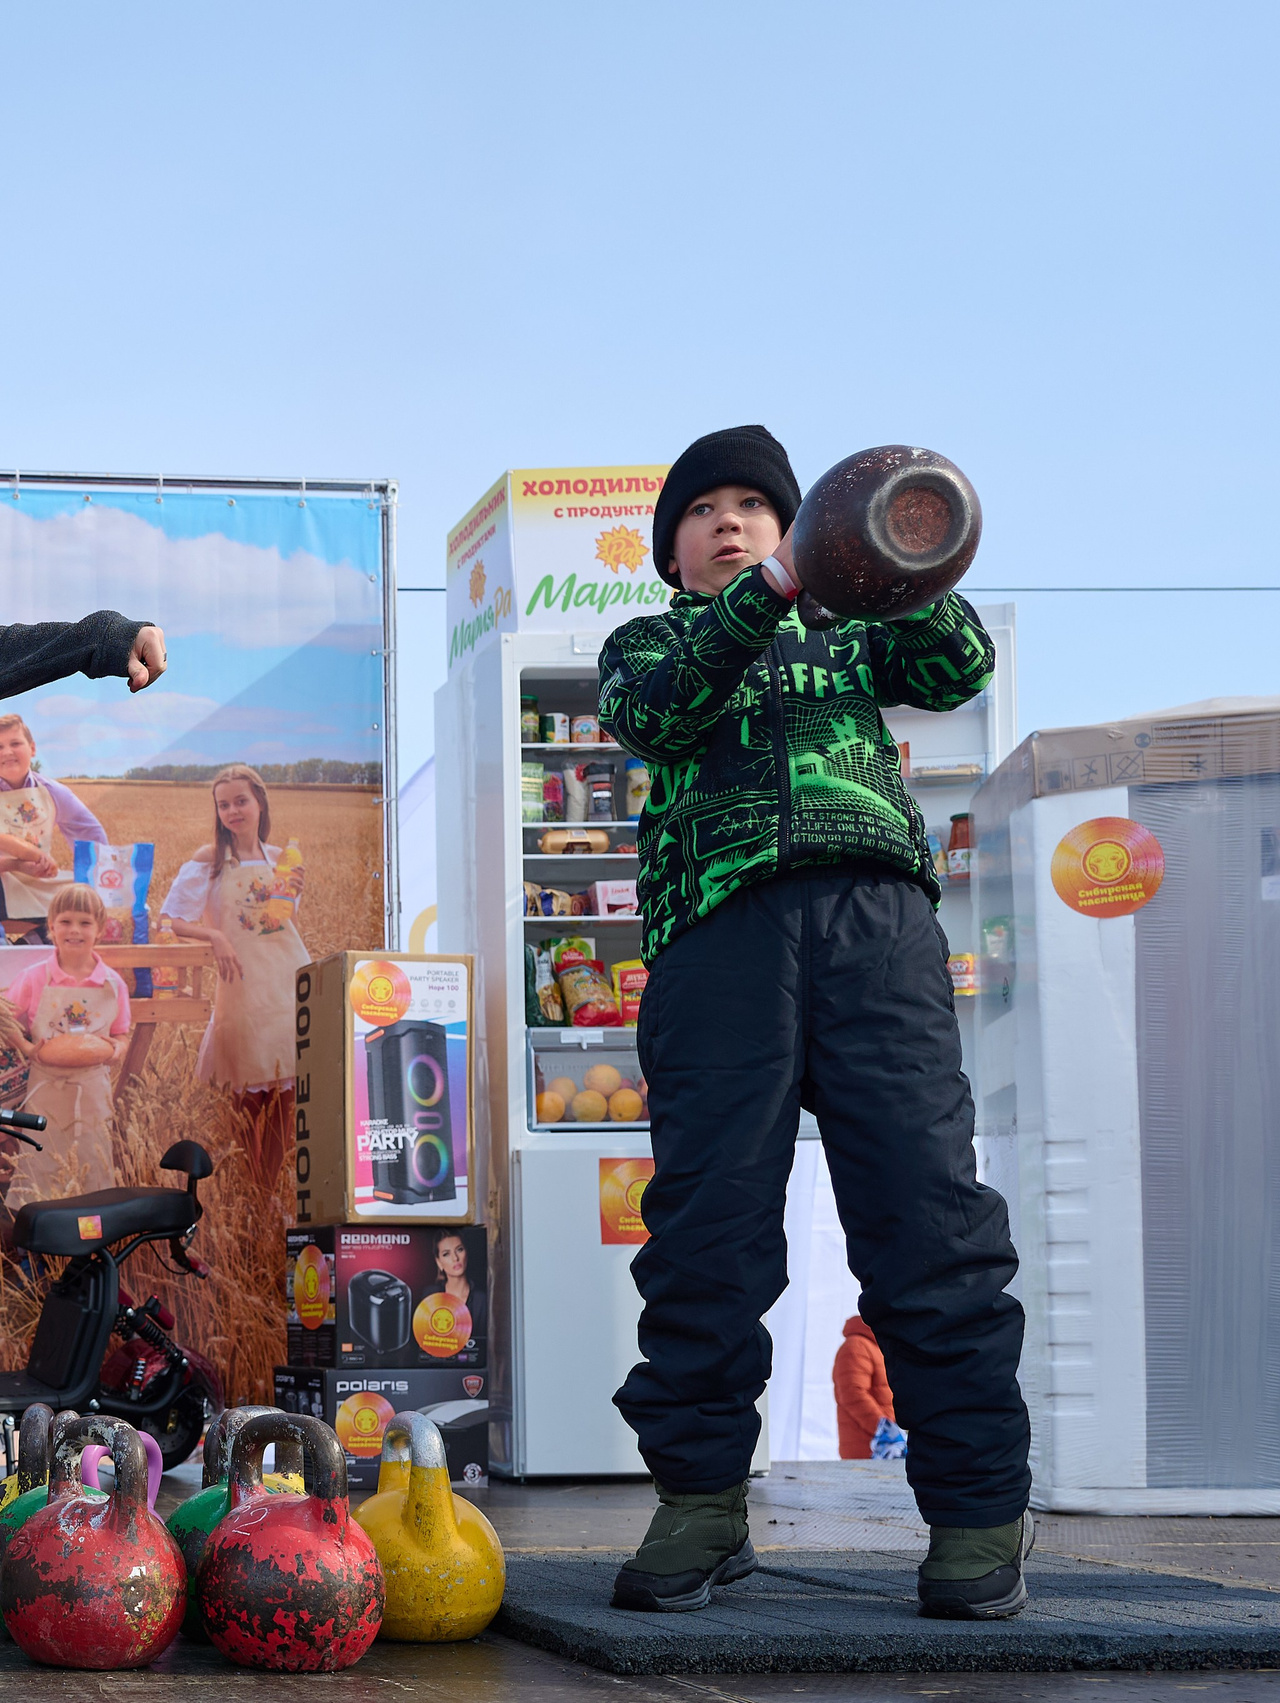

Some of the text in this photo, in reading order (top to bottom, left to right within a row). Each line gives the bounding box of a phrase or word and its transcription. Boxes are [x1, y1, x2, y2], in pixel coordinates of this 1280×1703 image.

[554, 507, 564, 518] С
[819, 812, 855, 822] STRONG
[858, 815, 875, 825] AND
[837, 823, 864, 833] ONLY
[1078, 882, 1143, 898] Сибирская
[296, 972, 312, 1223] HOPE 100
[357, 1132, 419, 1152] PARTY
[341, 1234, 411, 1245] REDMOND
[336, 1379, 409, 1393] polaris
